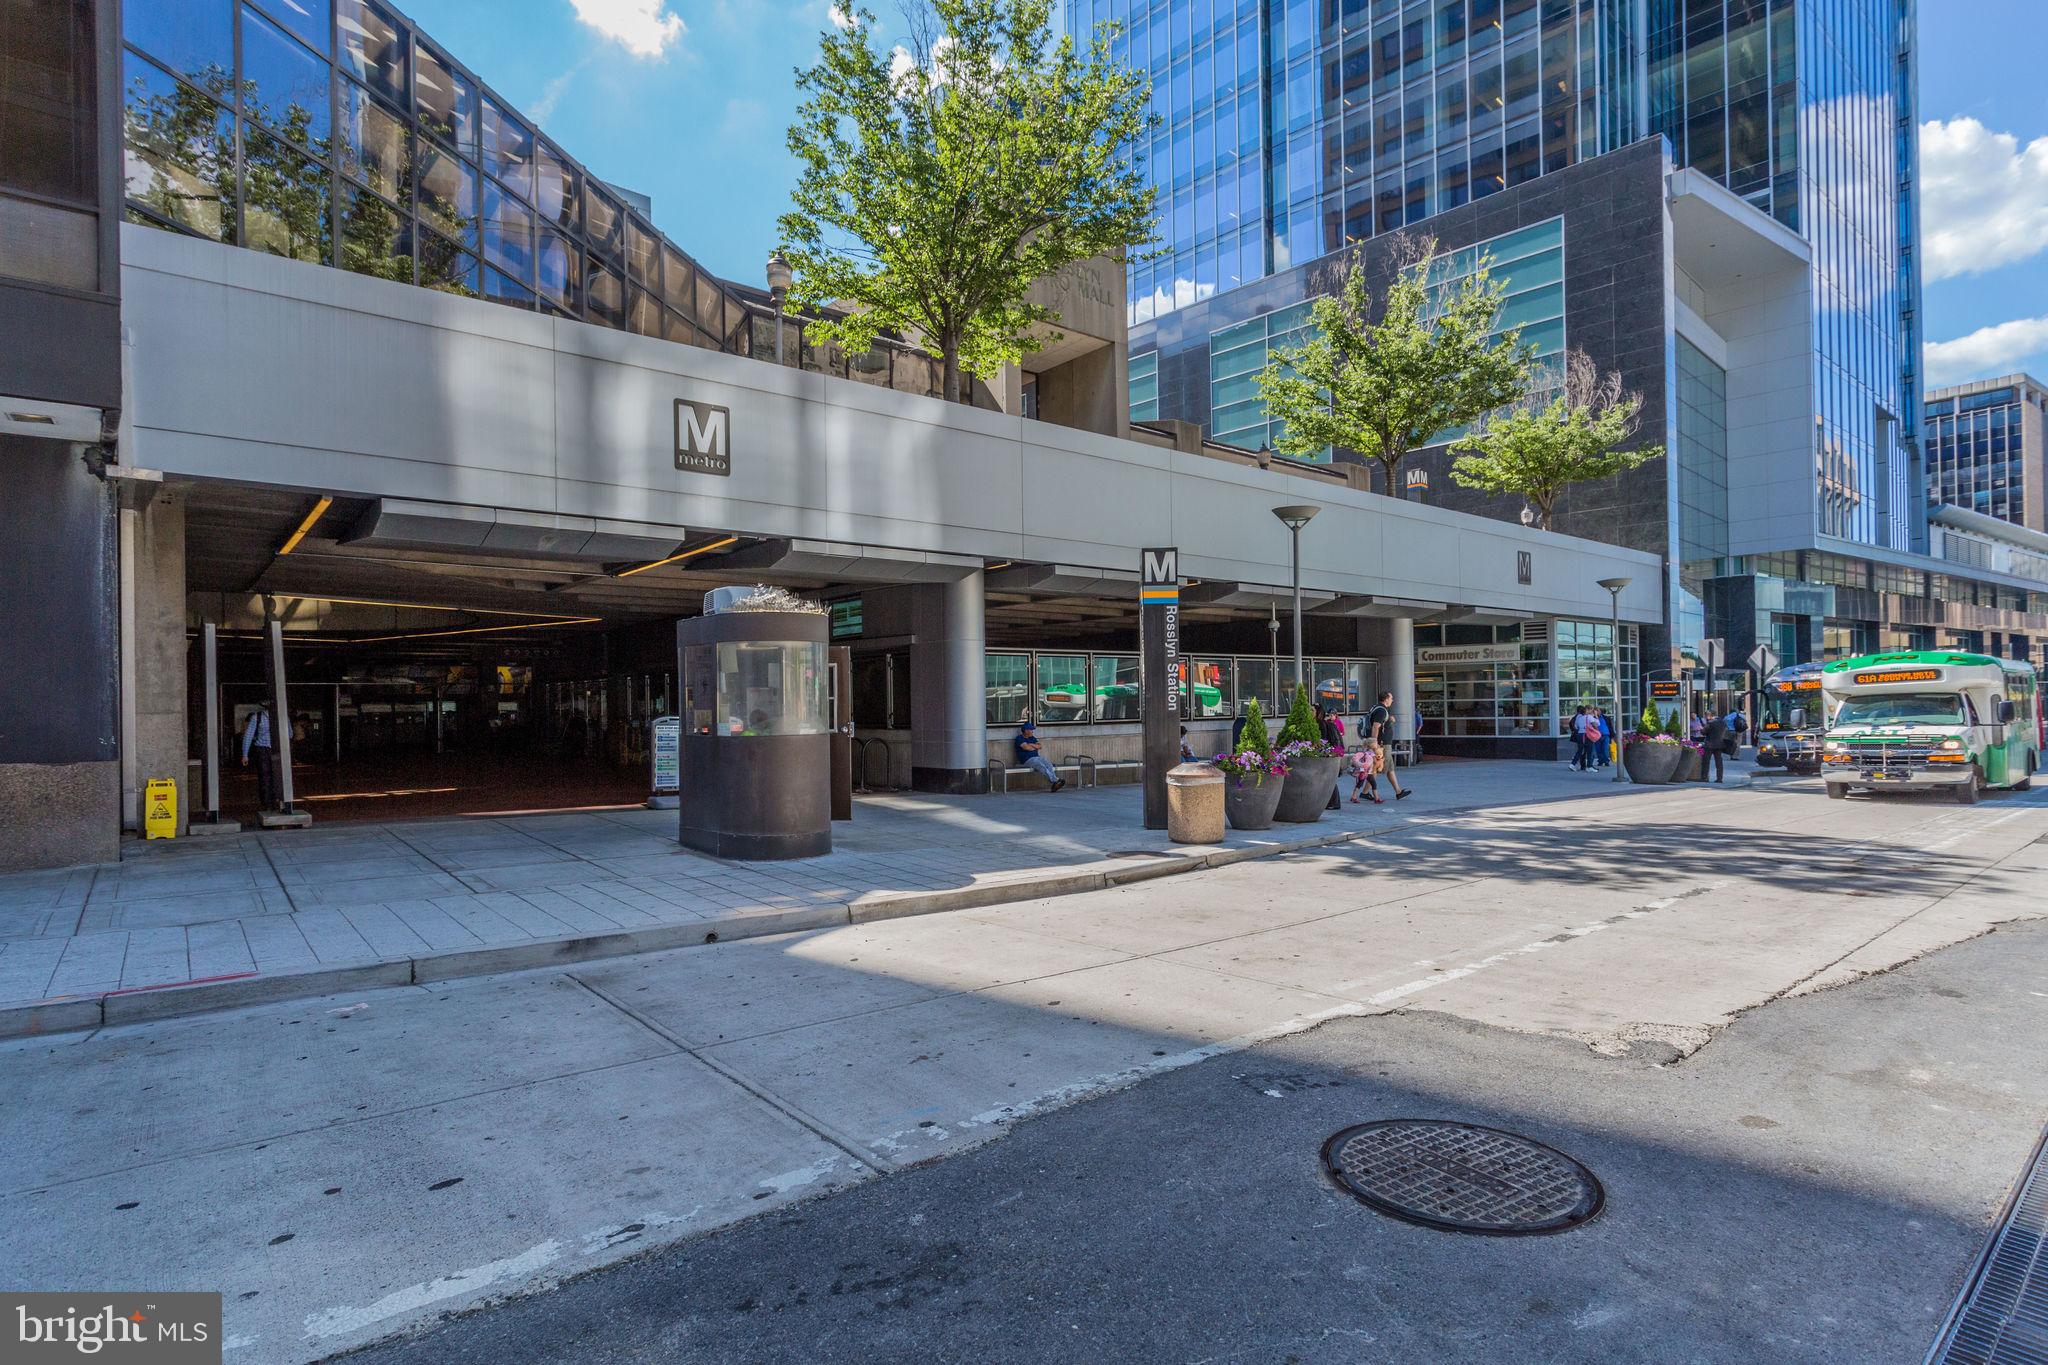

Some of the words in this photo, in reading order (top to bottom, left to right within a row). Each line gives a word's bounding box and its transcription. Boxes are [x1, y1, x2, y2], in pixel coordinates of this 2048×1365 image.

[1078, 281, 1115, 308] MALL
[678, 404, 726, 456] M
[679, 454, 727, 470] metro
[1144, 551, 1177, 583] M
[1519, 552, 1530, 577] M
[1166, 605, 1179, 658] Rosslyn
[1421, 649, 1481, 662] Commuter
[1482, 647, 1515, 660] Store
[1167, 663, 1180, 712] Station
[1857, 673, 1877, 684] 61A
